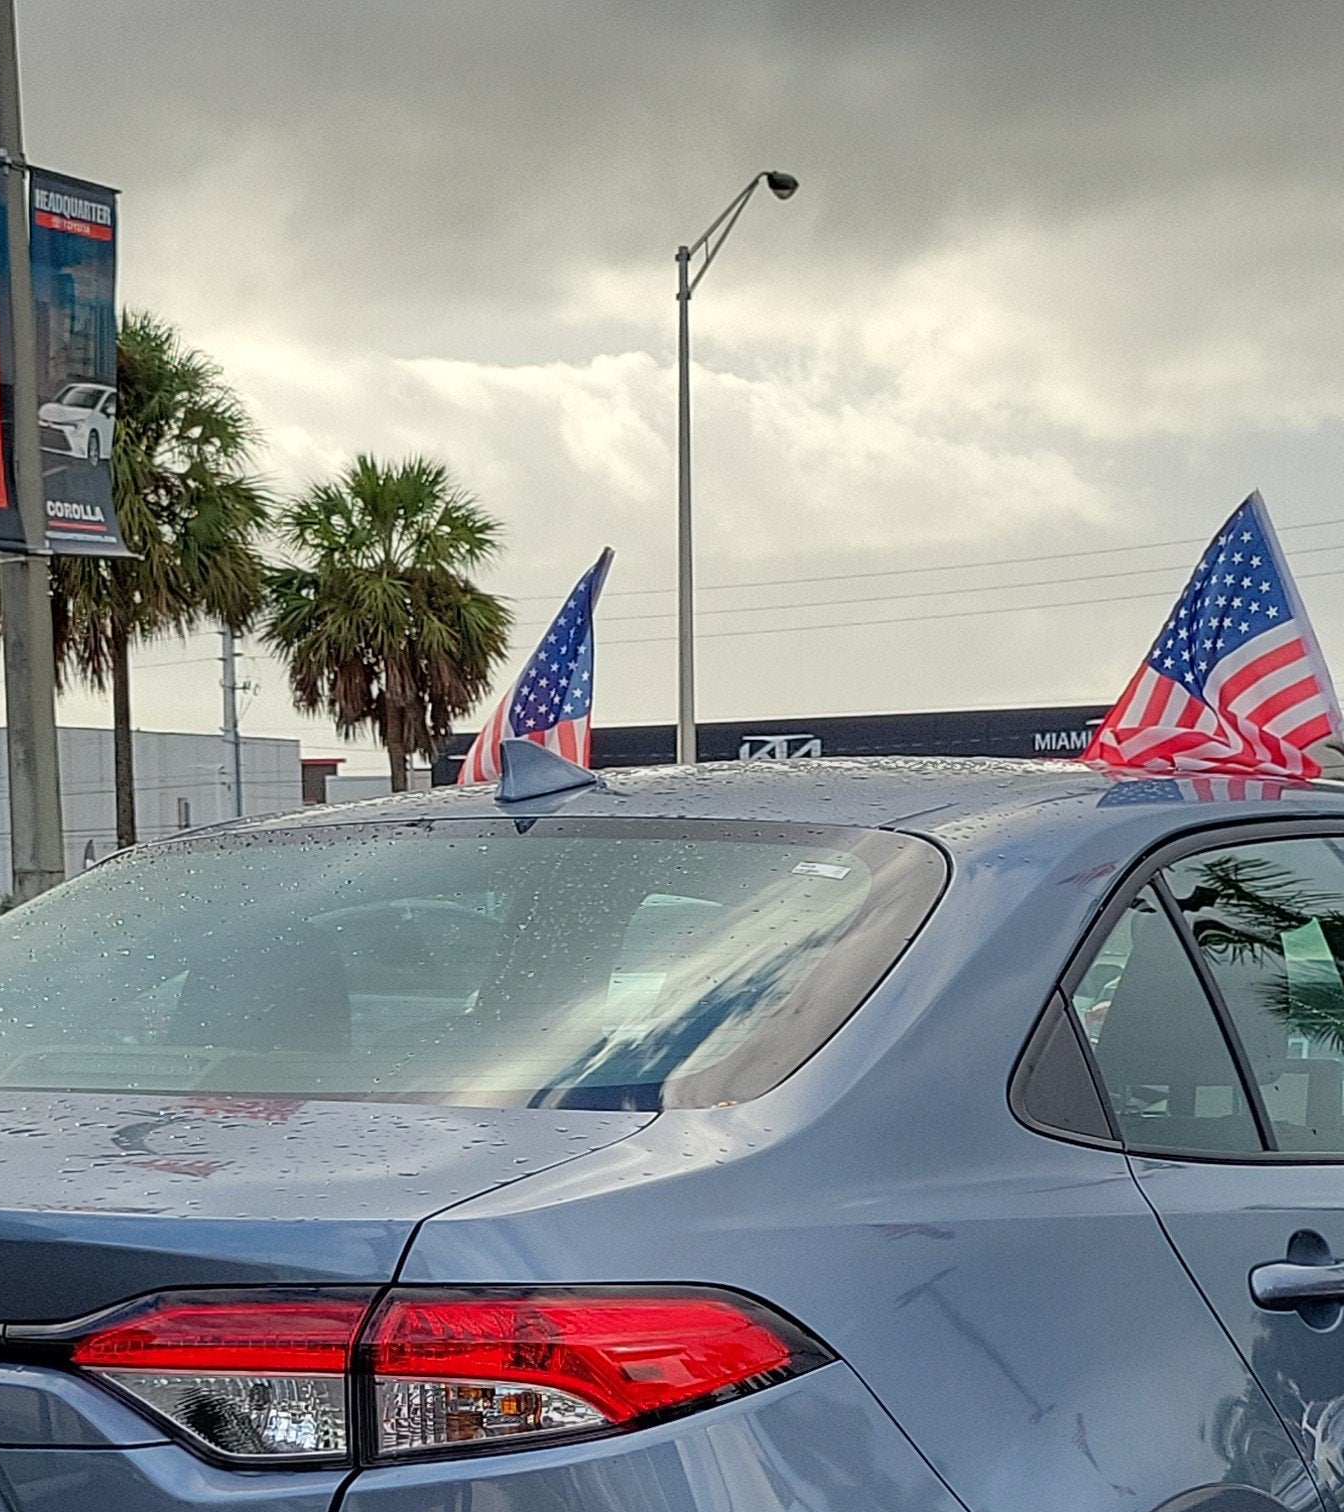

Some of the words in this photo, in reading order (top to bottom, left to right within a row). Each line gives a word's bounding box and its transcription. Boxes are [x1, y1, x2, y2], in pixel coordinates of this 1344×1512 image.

[35, 188, 111, 226] HEADQUARTER
[46, 500, 106, 522] COROLLA
[1035, 730, 1093, 750] MIAMI
